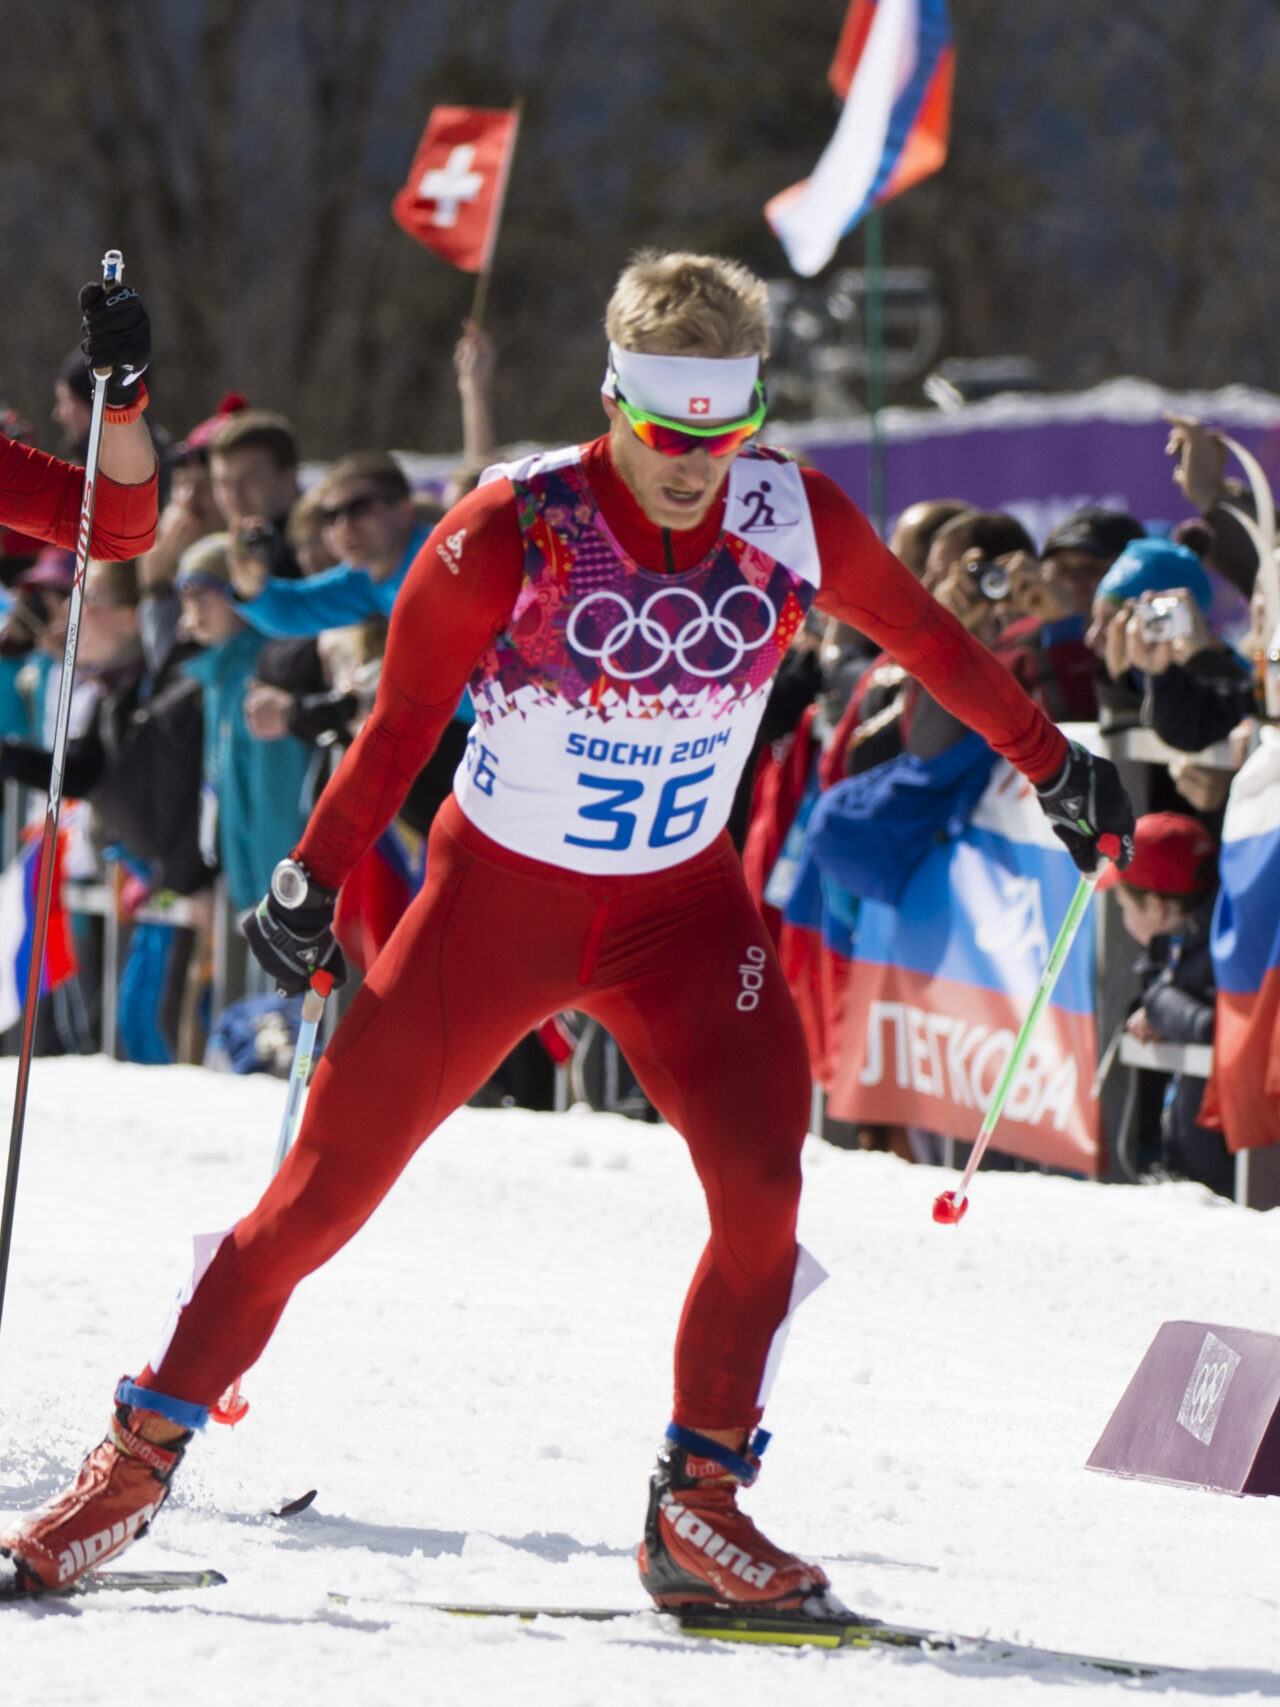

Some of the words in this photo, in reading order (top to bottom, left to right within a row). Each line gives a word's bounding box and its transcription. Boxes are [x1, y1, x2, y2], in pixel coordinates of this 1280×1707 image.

[566, 733, 663, 766] SOCHI
[670, 727, 732, 764] 2014
[563, 764, 716, 851] 36
[736, 945, 766, 1011] odlo
